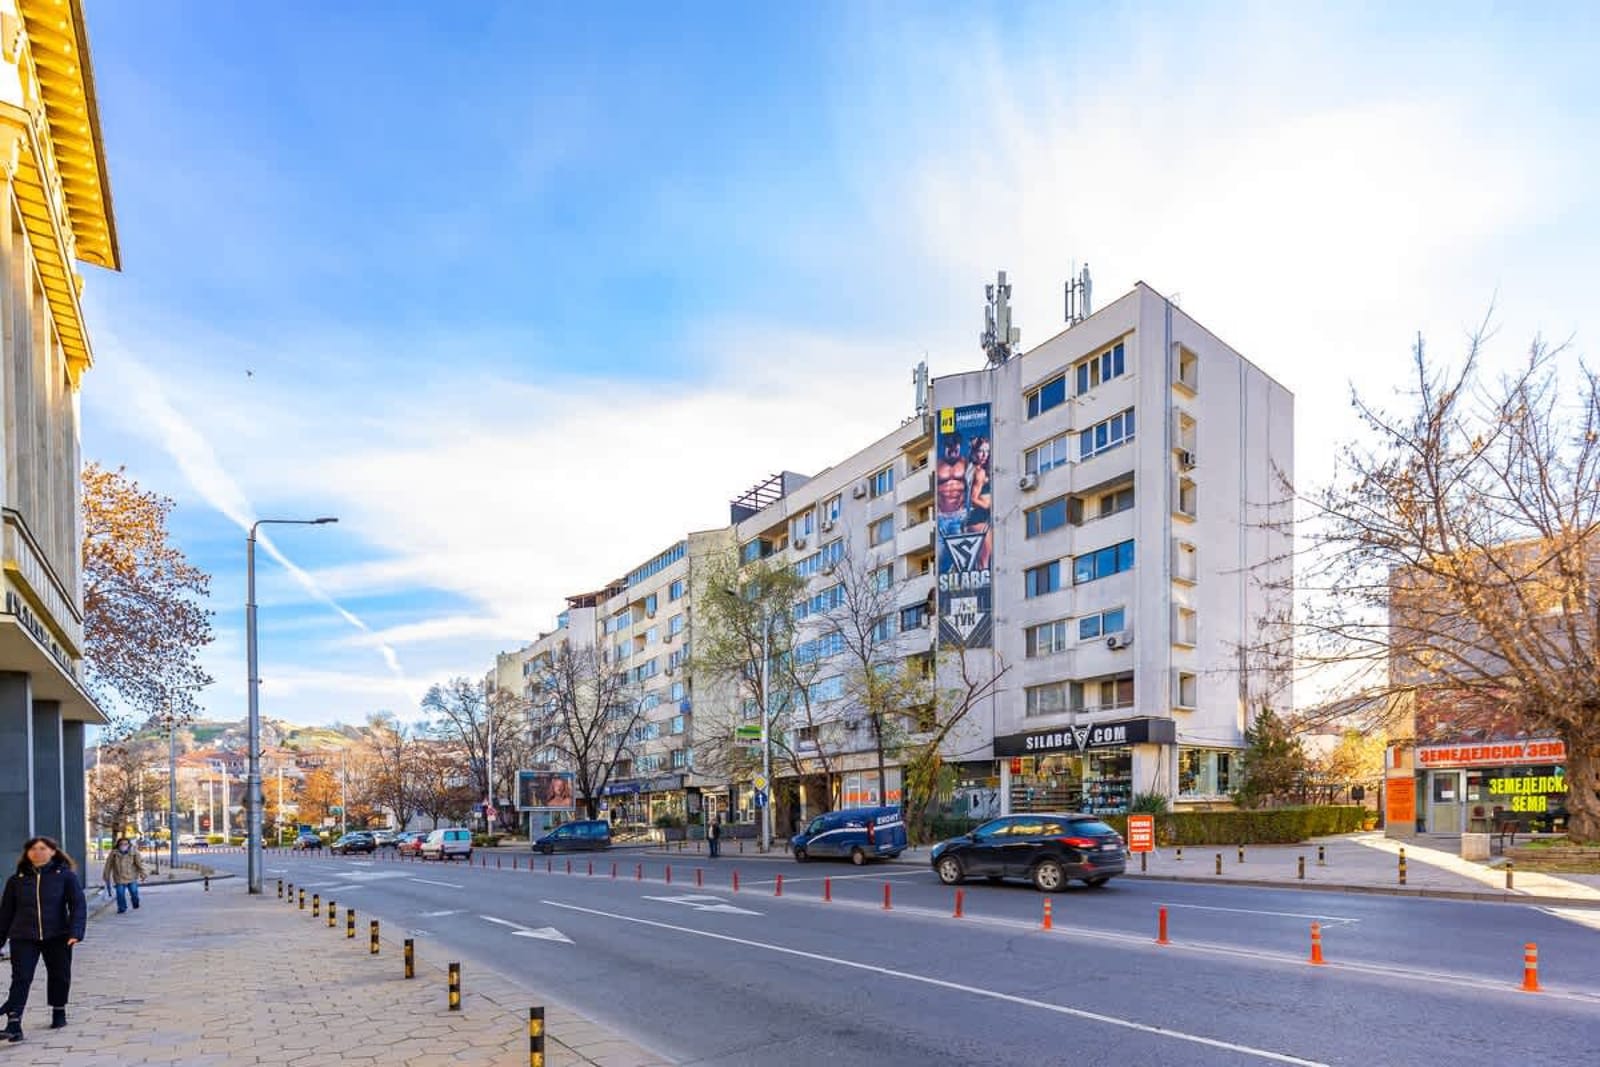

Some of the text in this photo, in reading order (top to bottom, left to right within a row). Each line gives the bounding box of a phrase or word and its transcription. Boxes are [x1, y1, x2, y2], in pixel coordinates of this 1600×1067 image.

[1025, 726, 1126, 750] SILABG .COM
[1419, 742, 1563, 762] ЗЕМЕДЕЛСКА ЗЕМ
[1512, 796, 1546, 812] ЗЕМЯ
